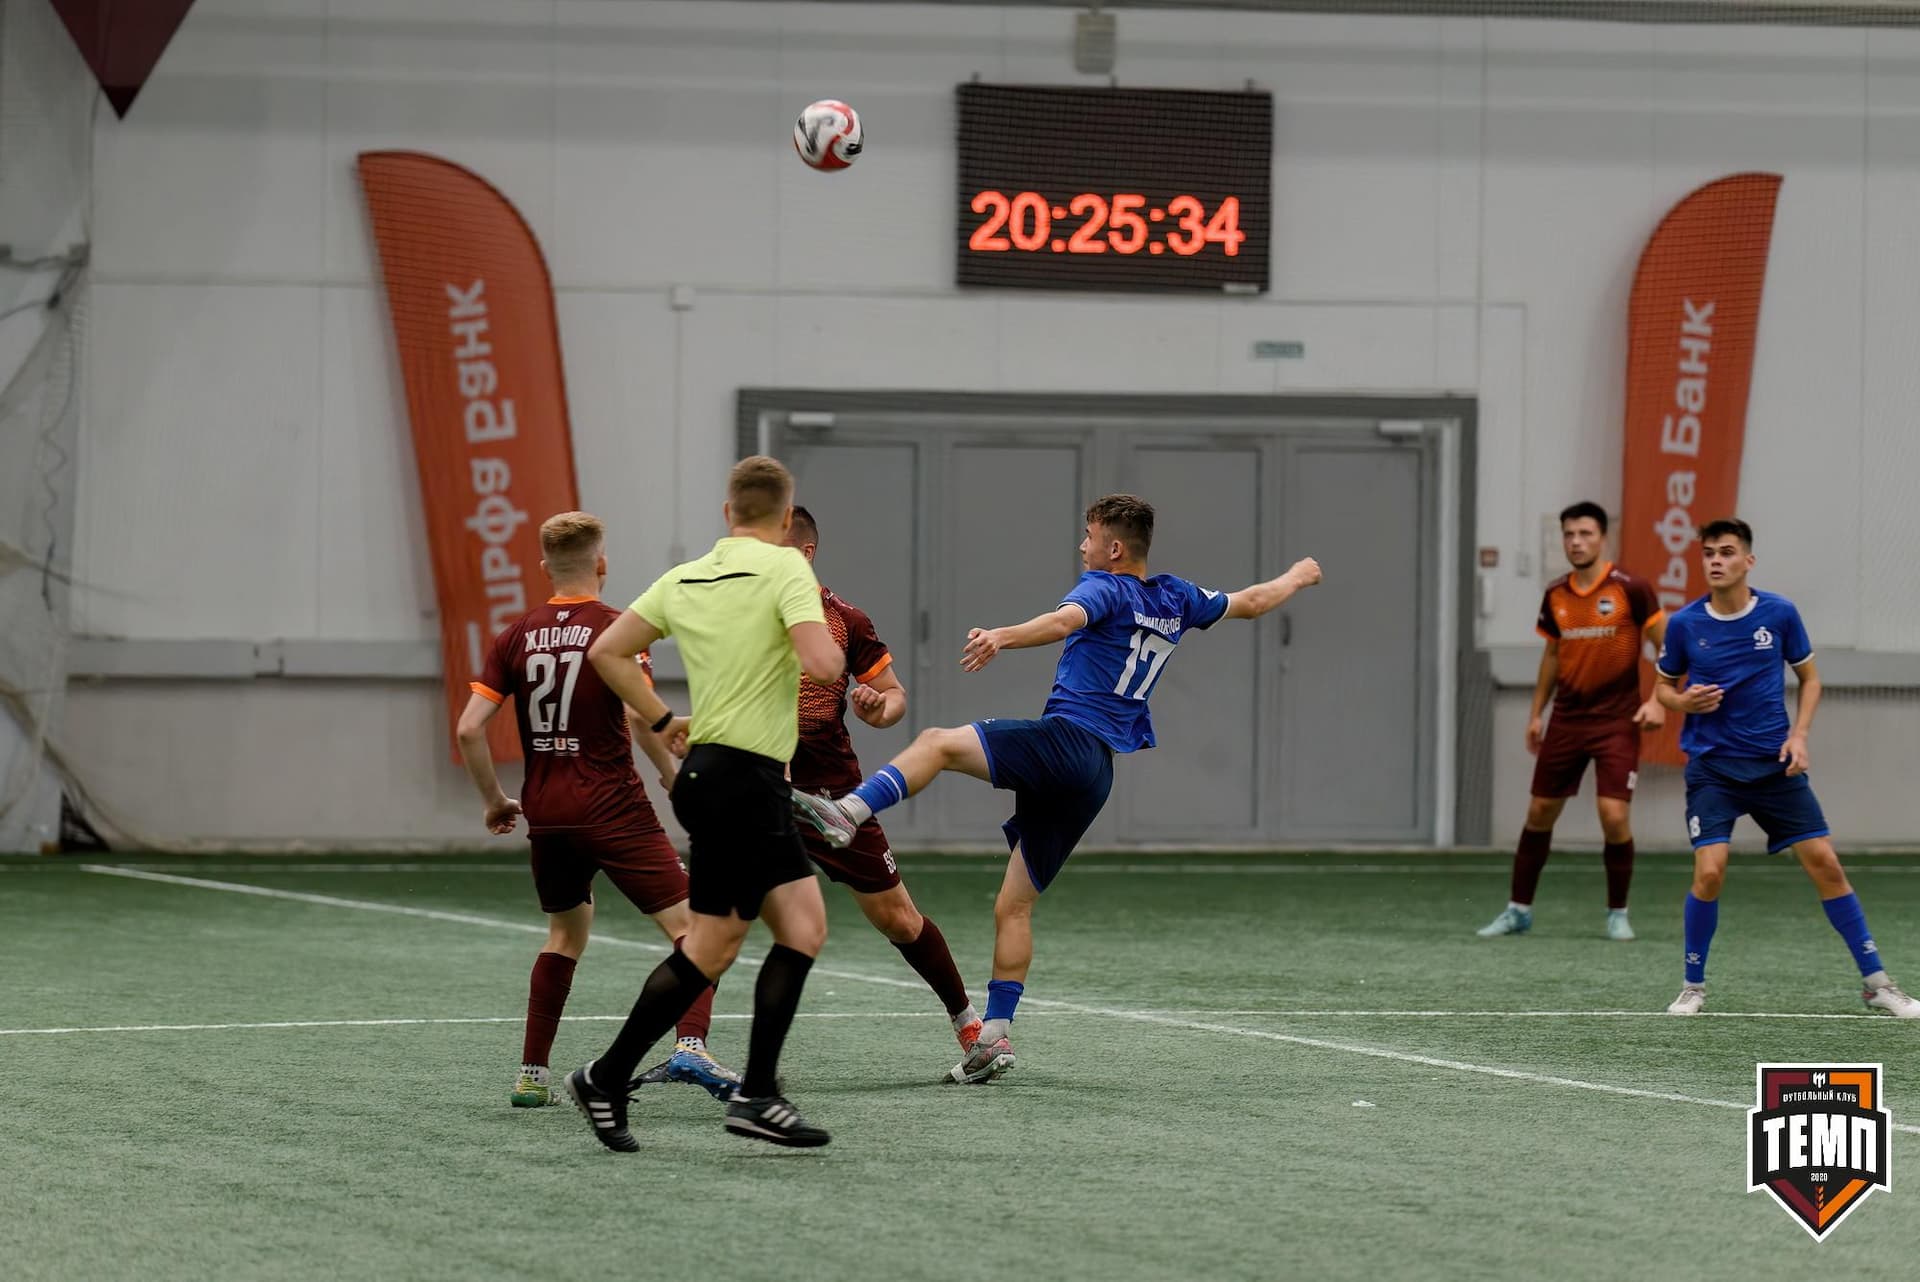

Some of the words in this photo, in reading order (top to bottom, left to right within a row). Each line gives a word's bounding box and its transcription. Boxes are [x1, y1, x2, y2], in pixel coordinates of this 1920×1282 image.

[969, 191, 1246, 257] 20:25:34
[1661, 298, 1717, 458] Банк
[525, 625, 593, 652] ЖДАНОВ
[1113, 629, 1177, 700] 17
[526, 651, 584, 733] 27
